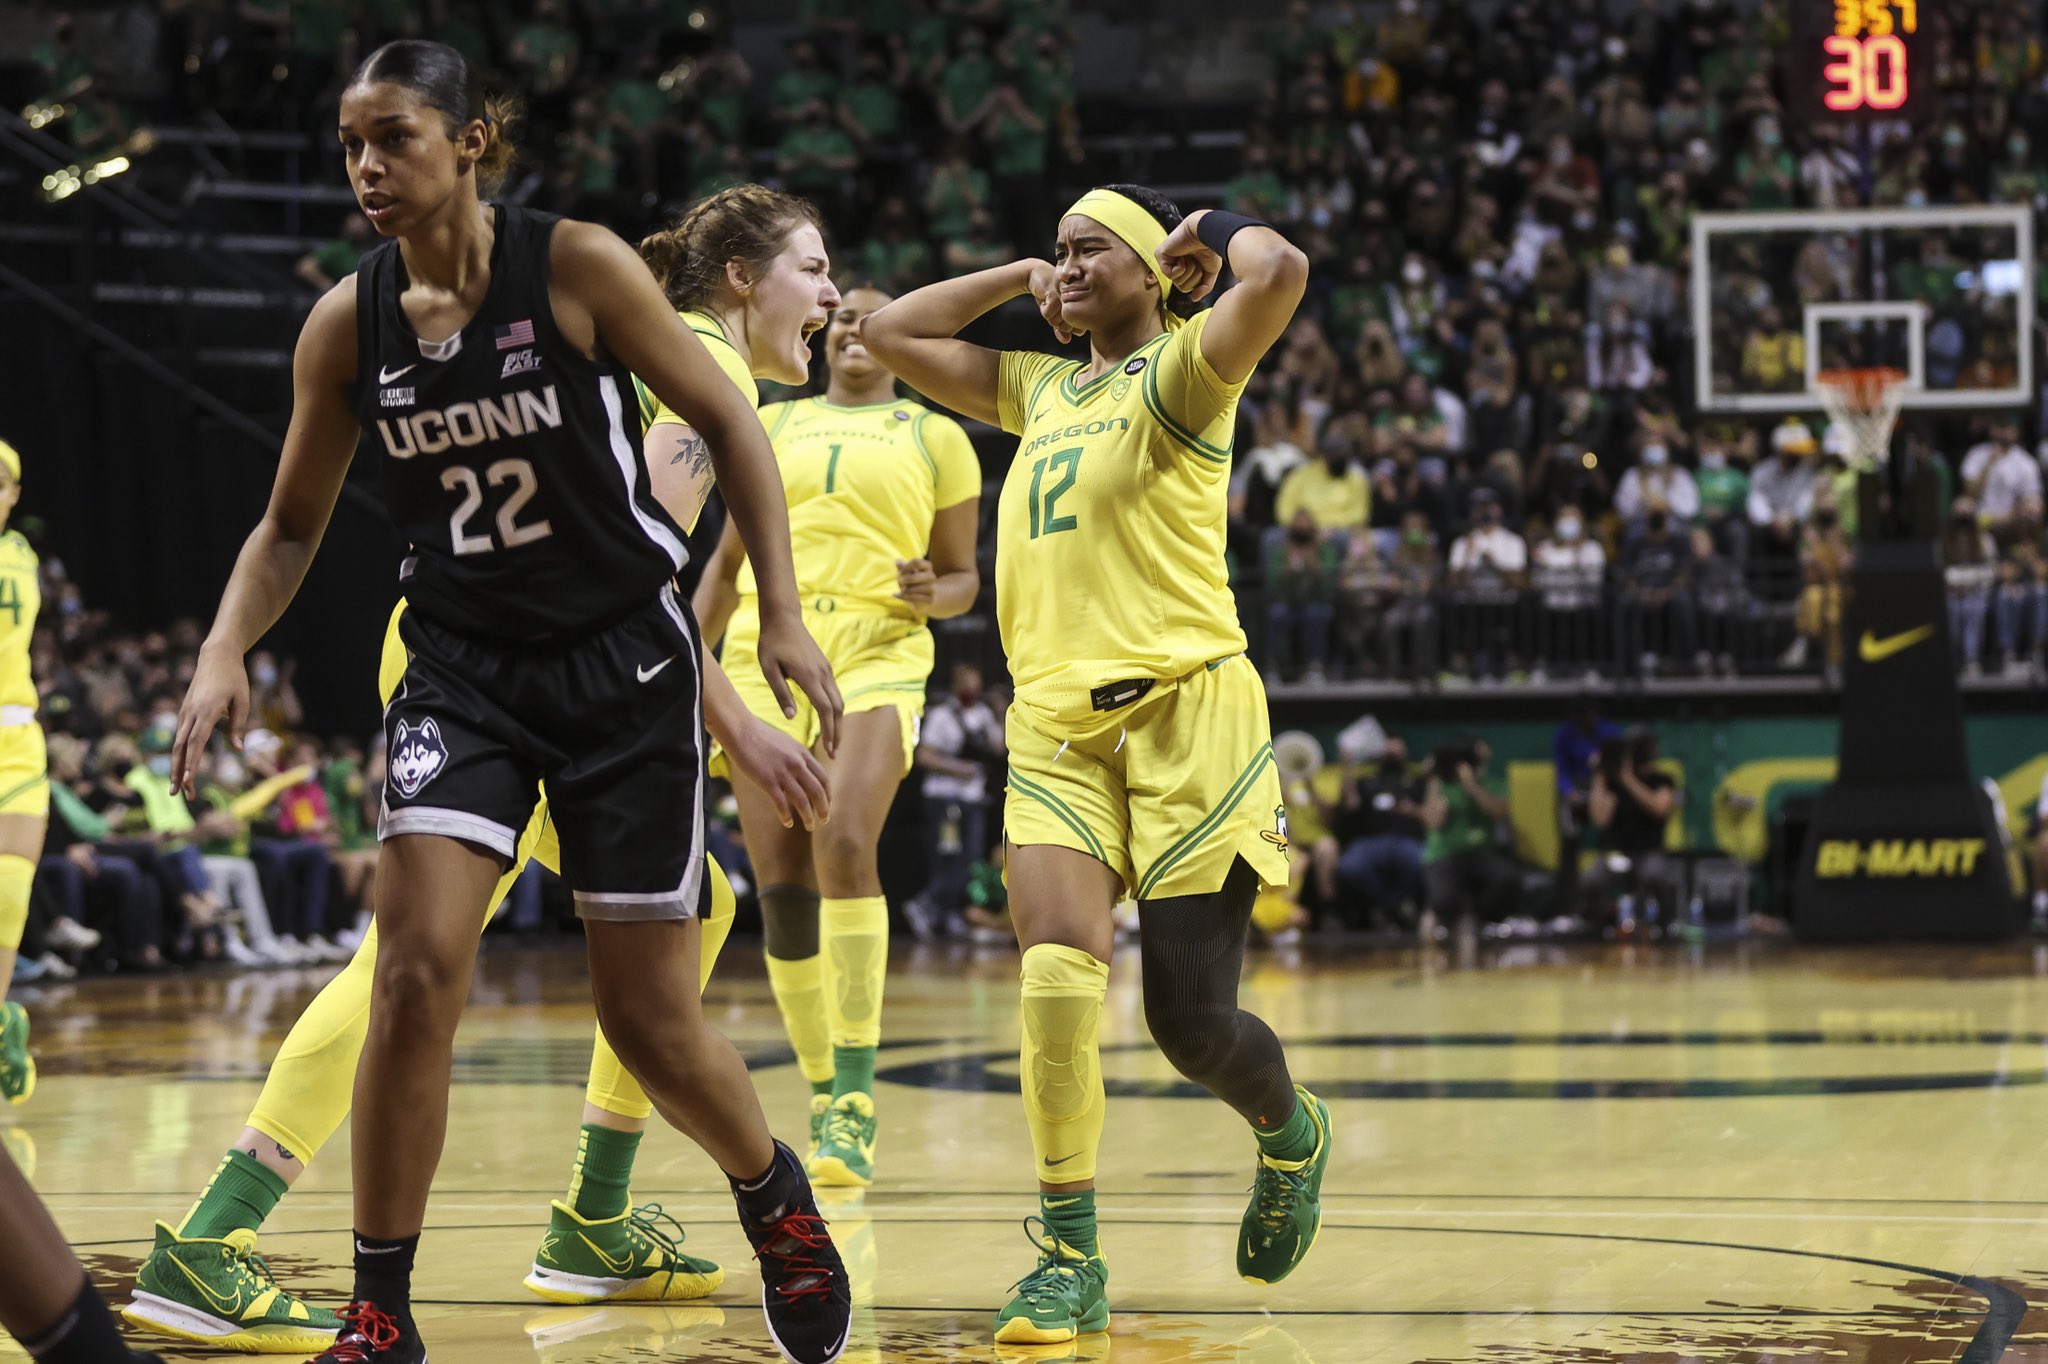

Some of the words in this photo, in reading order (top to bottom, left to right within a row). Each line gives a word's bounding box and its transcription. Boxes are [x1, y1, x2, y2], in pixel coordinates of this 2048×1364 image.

[1823, 34, 1908, 111] 30
[377, 384, 563, 460] UCONN
[1025, 417, 1128, 457] OREGON
[439, 458, 553, 556] 22
[825, 444, 842, 494] 1
[1029, 446, 1084, 540] 12
